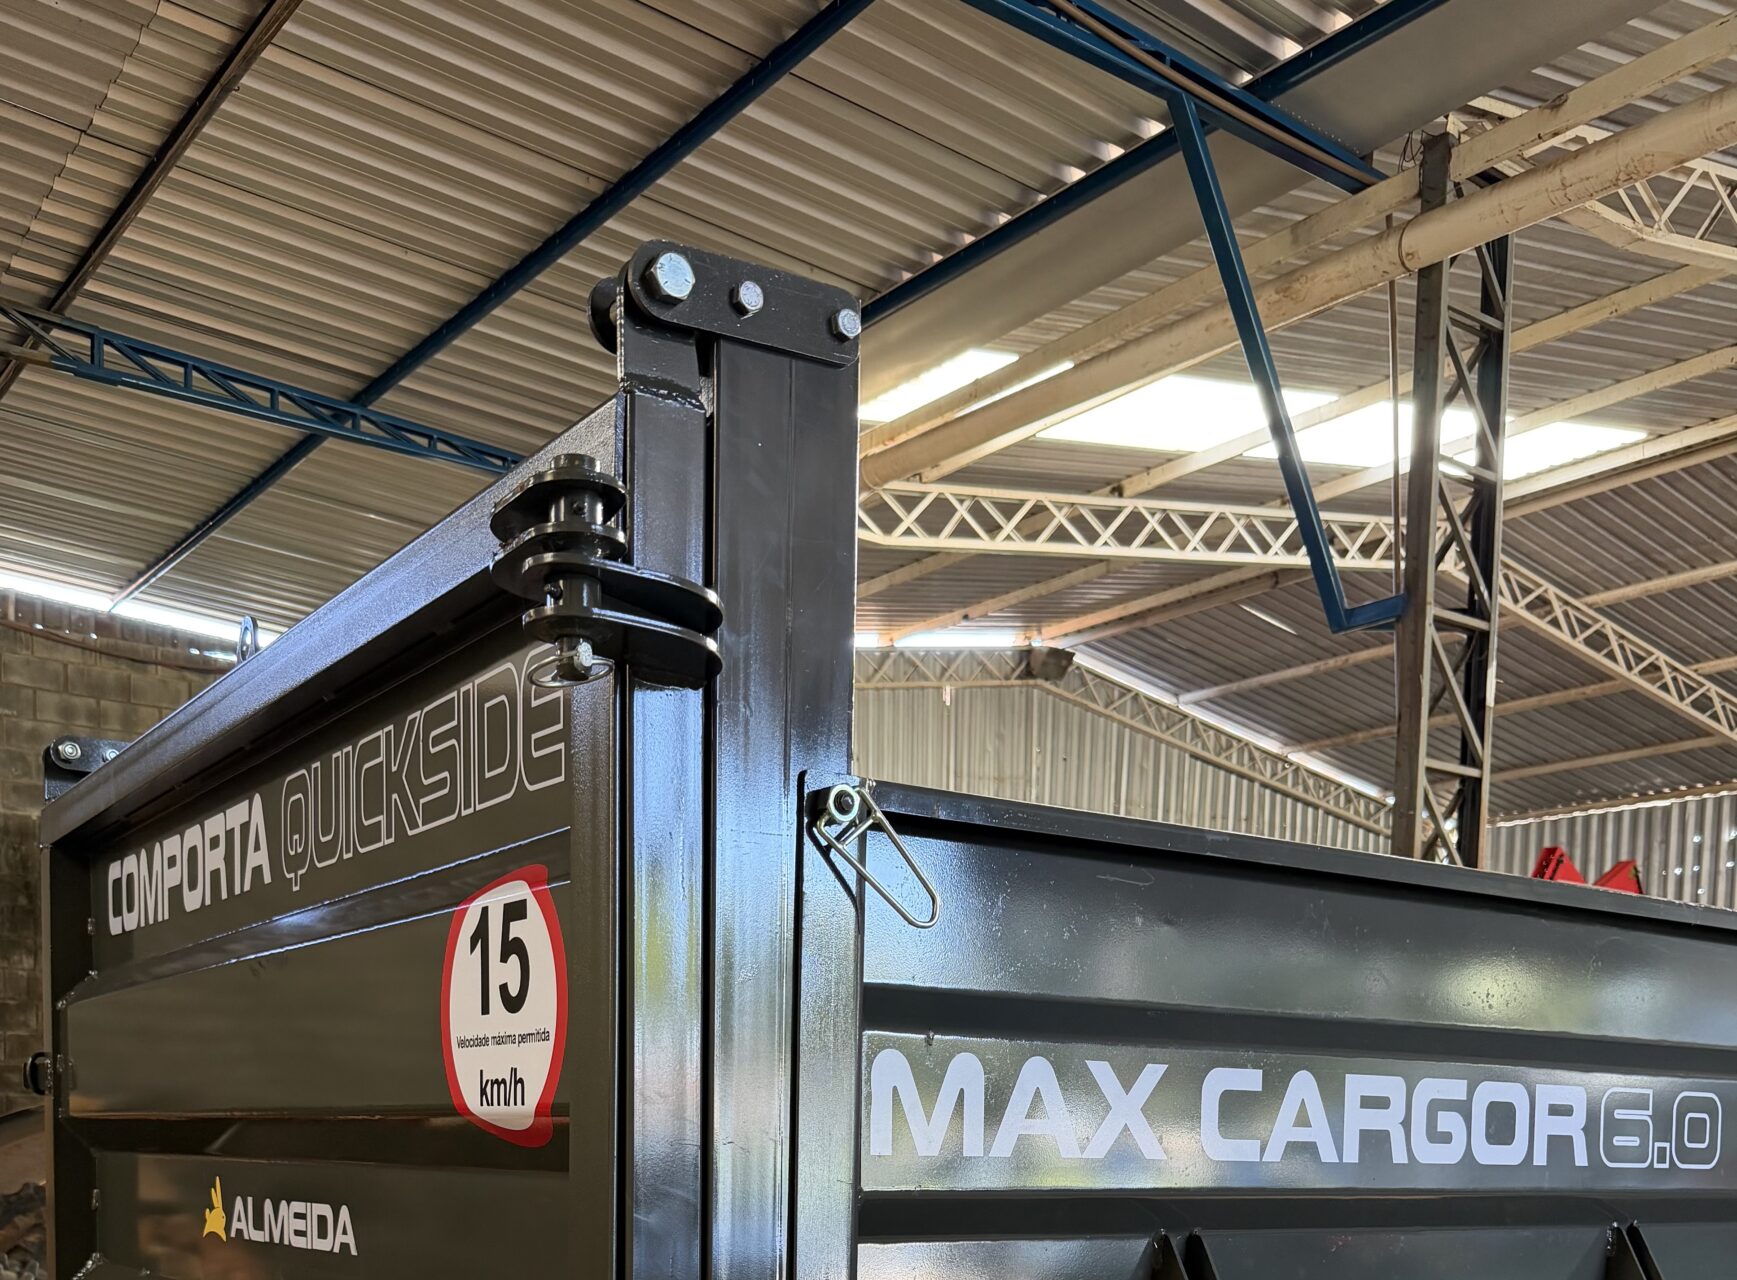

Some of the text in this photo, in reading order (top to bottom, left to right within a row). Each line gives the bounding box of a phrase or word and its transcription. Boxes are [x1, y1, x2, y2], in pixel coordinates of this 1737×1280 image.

[107, 643, 566, 936] COMPORTA QUICKSIDE
[469, 898, 530, 1017] 15
[456, 1027, 550, 1049] Velocidade máxima permitida
[479, 1067, 525, 1107] km/h
[869, 1048, 1722, 1170] MAX CARGOR 6.0
[230, 1195, 358, 1256] ALMEIDA
